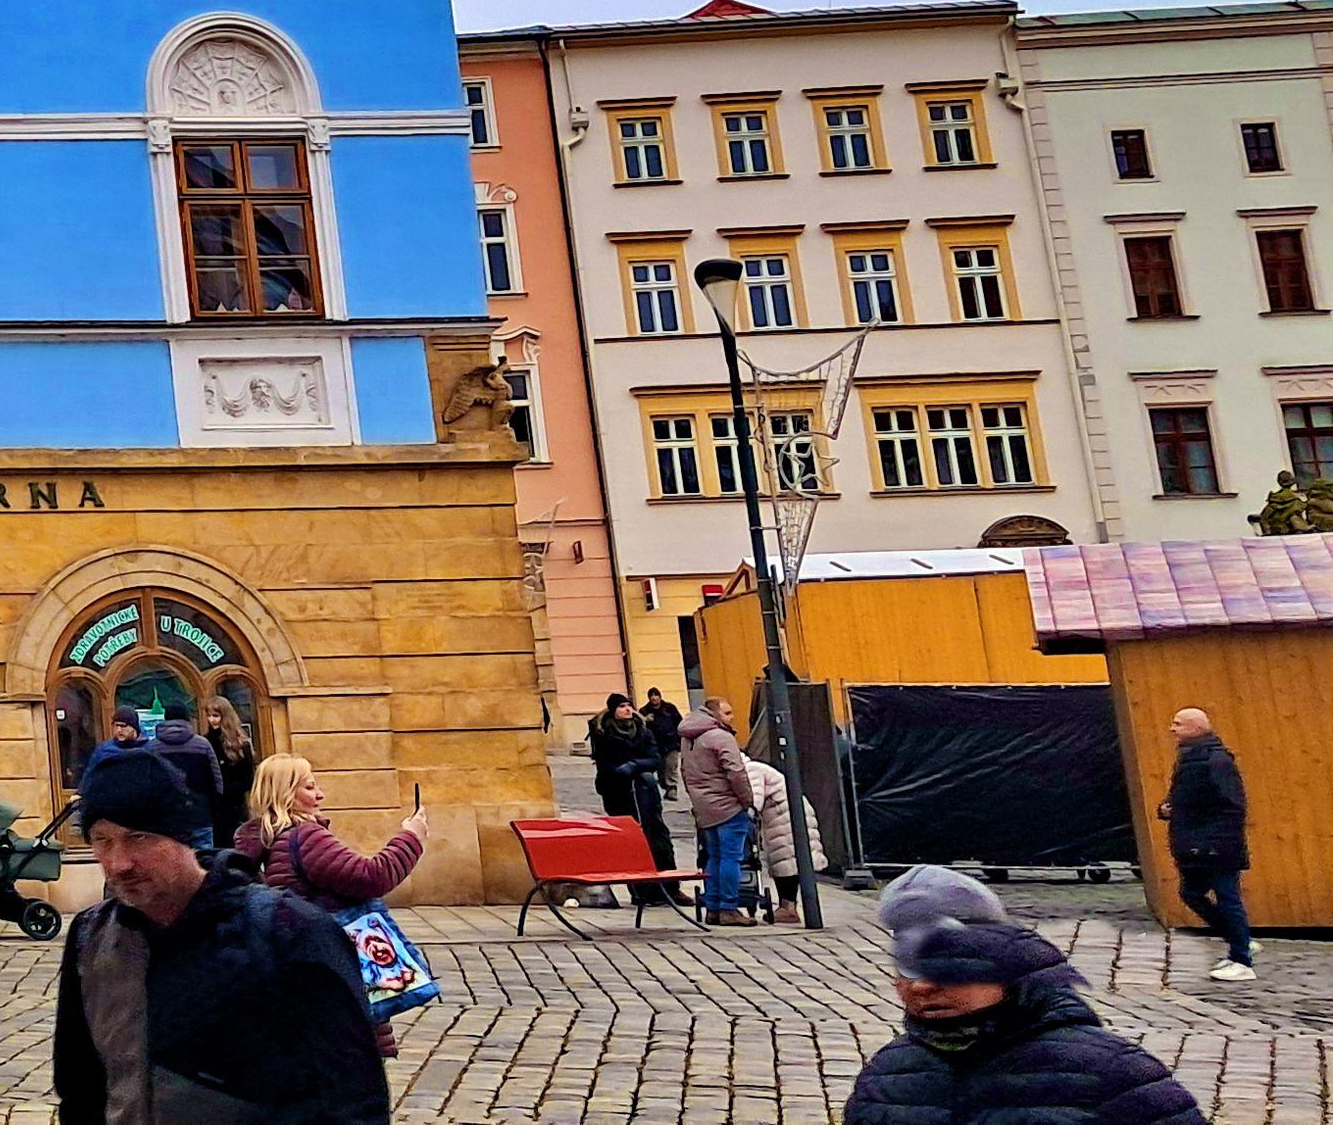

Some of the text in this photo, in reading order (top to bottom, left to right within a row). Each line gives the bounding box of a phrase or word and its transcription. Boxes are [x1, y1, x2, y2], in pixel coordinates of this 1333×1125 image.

[71, 604, 140, 665] ZDRAVOTNICKÉ
[92, 628, 138, 668] POTŘEBY
[160, 615, 225, 663] U TROJICE
